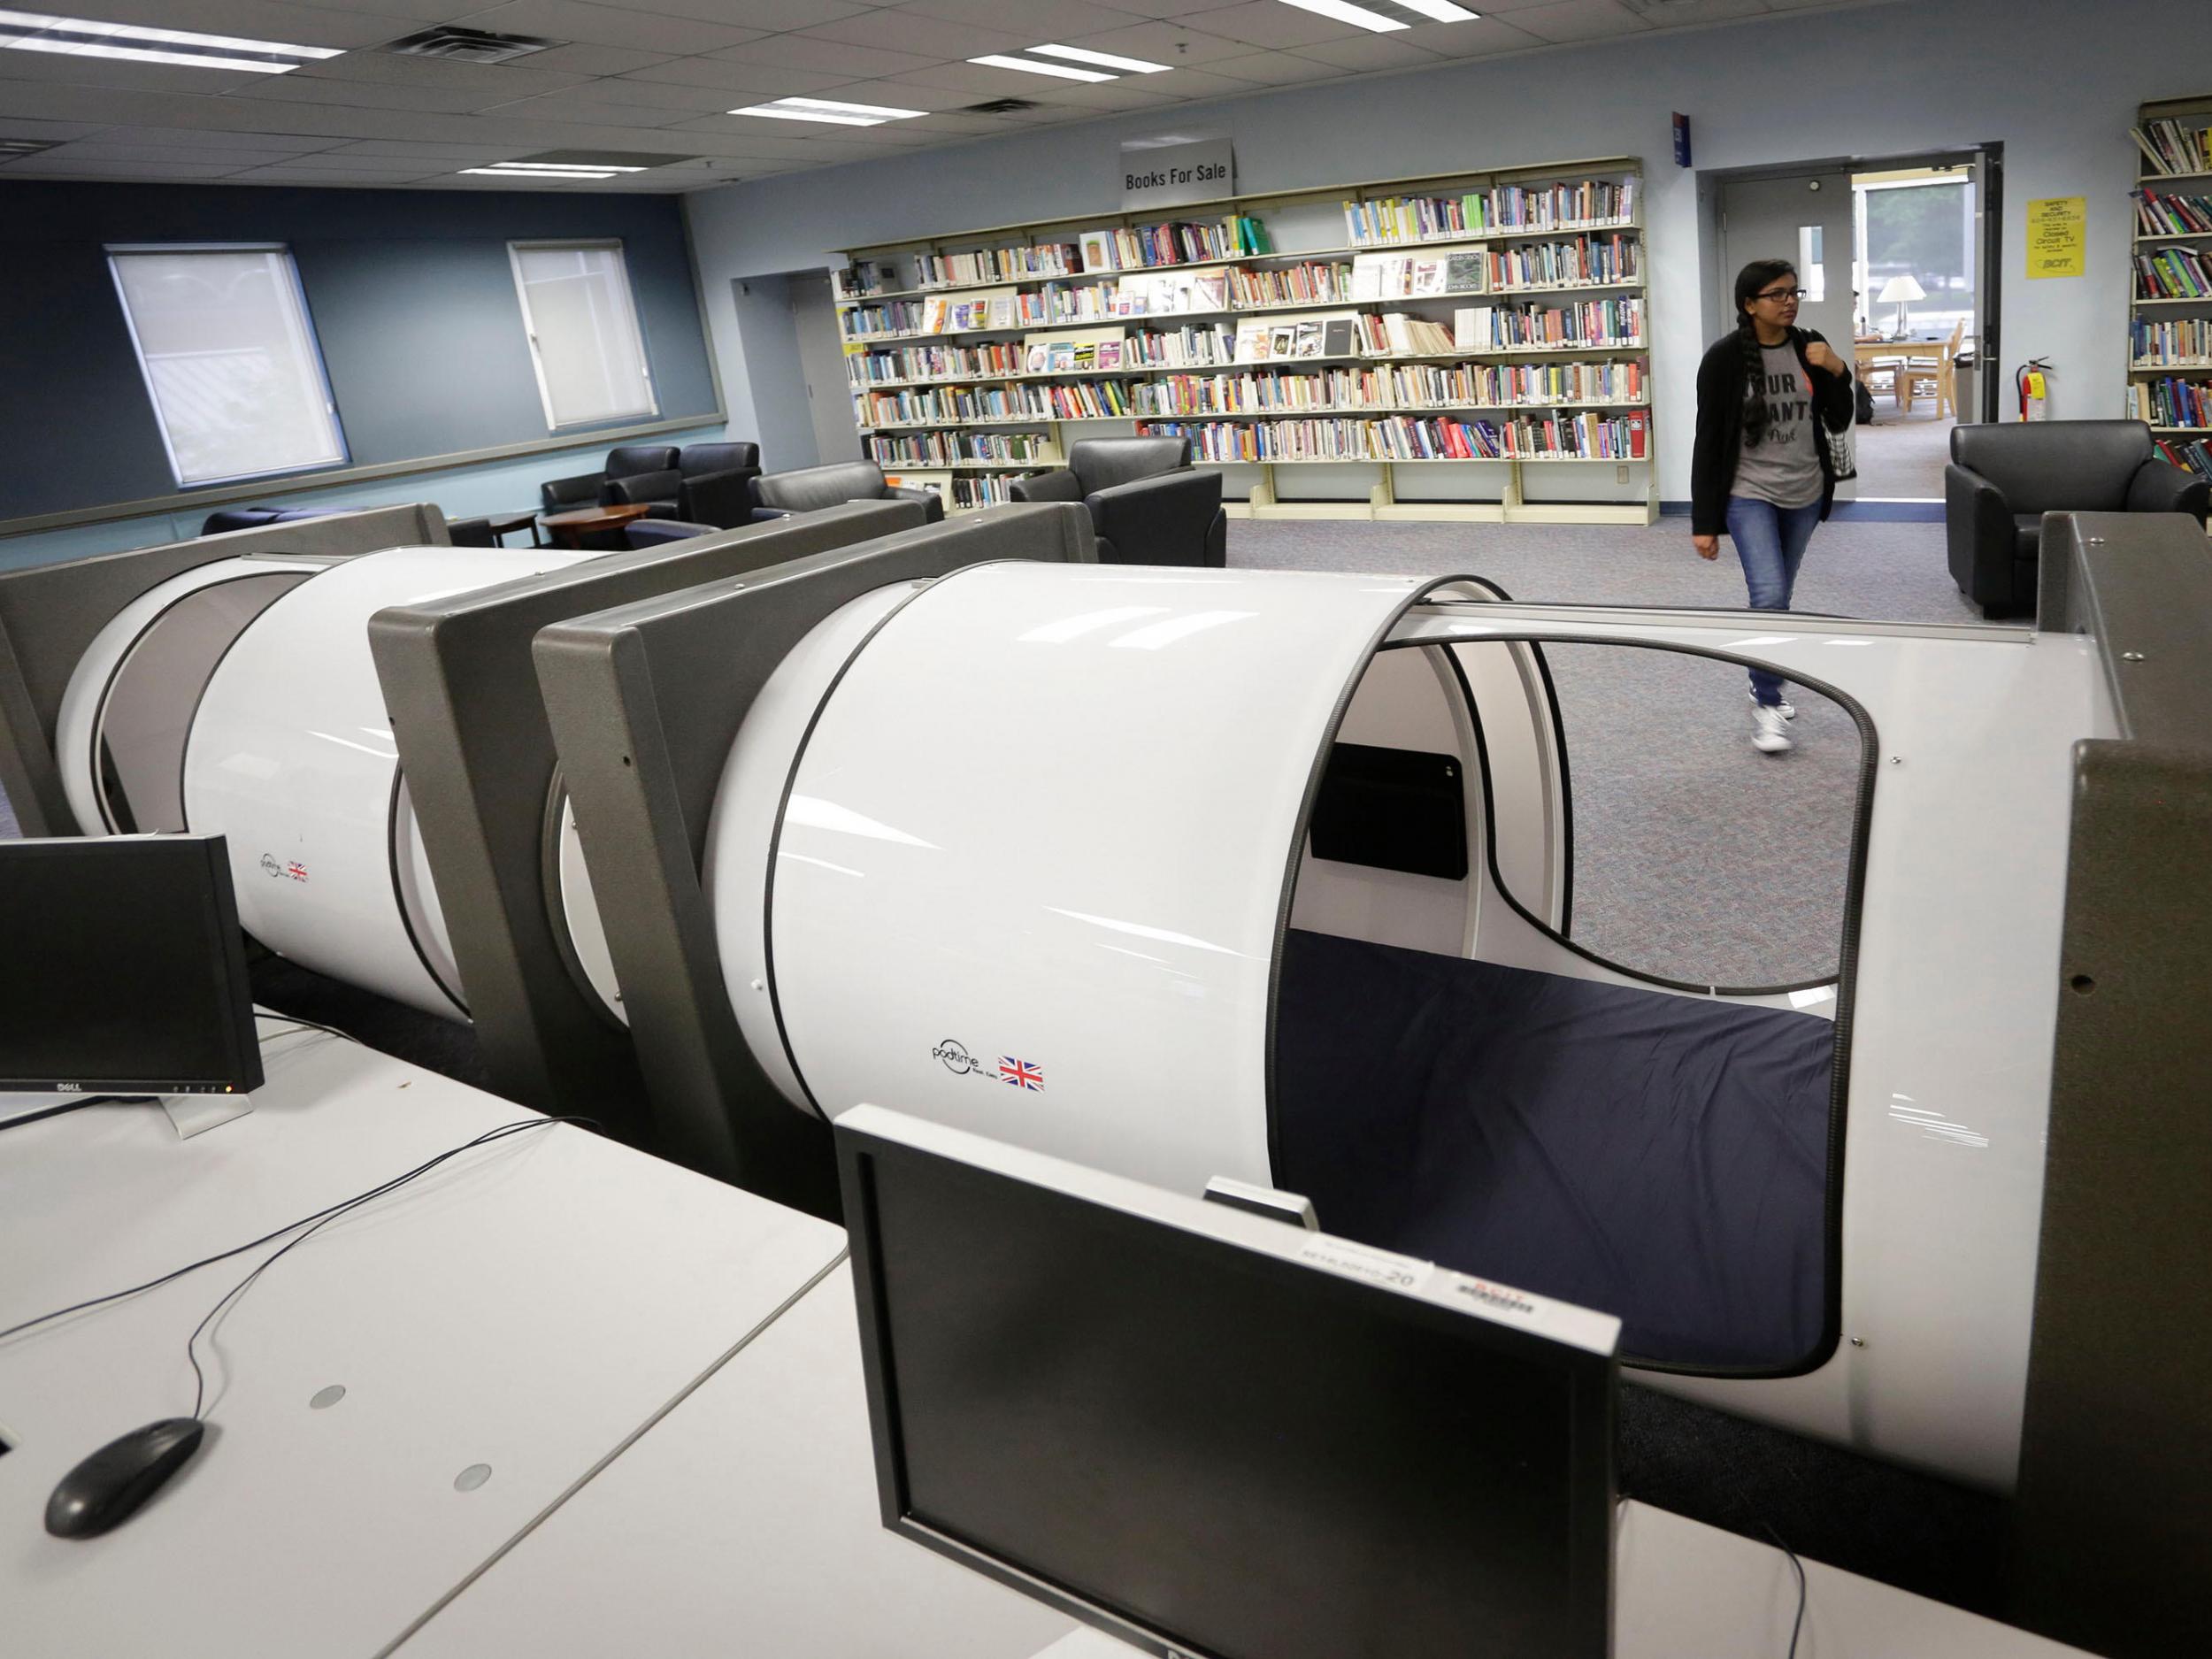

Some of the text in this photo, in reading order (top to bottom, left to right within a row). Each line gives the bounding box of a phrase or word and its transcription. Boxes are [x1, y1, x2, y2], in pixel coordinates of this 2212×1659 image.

[1125, 163, 1226, 190] Books For Sale
[932, 1046, 979, 1069] podtime
[56, 1082, 83, 1093] DELL
